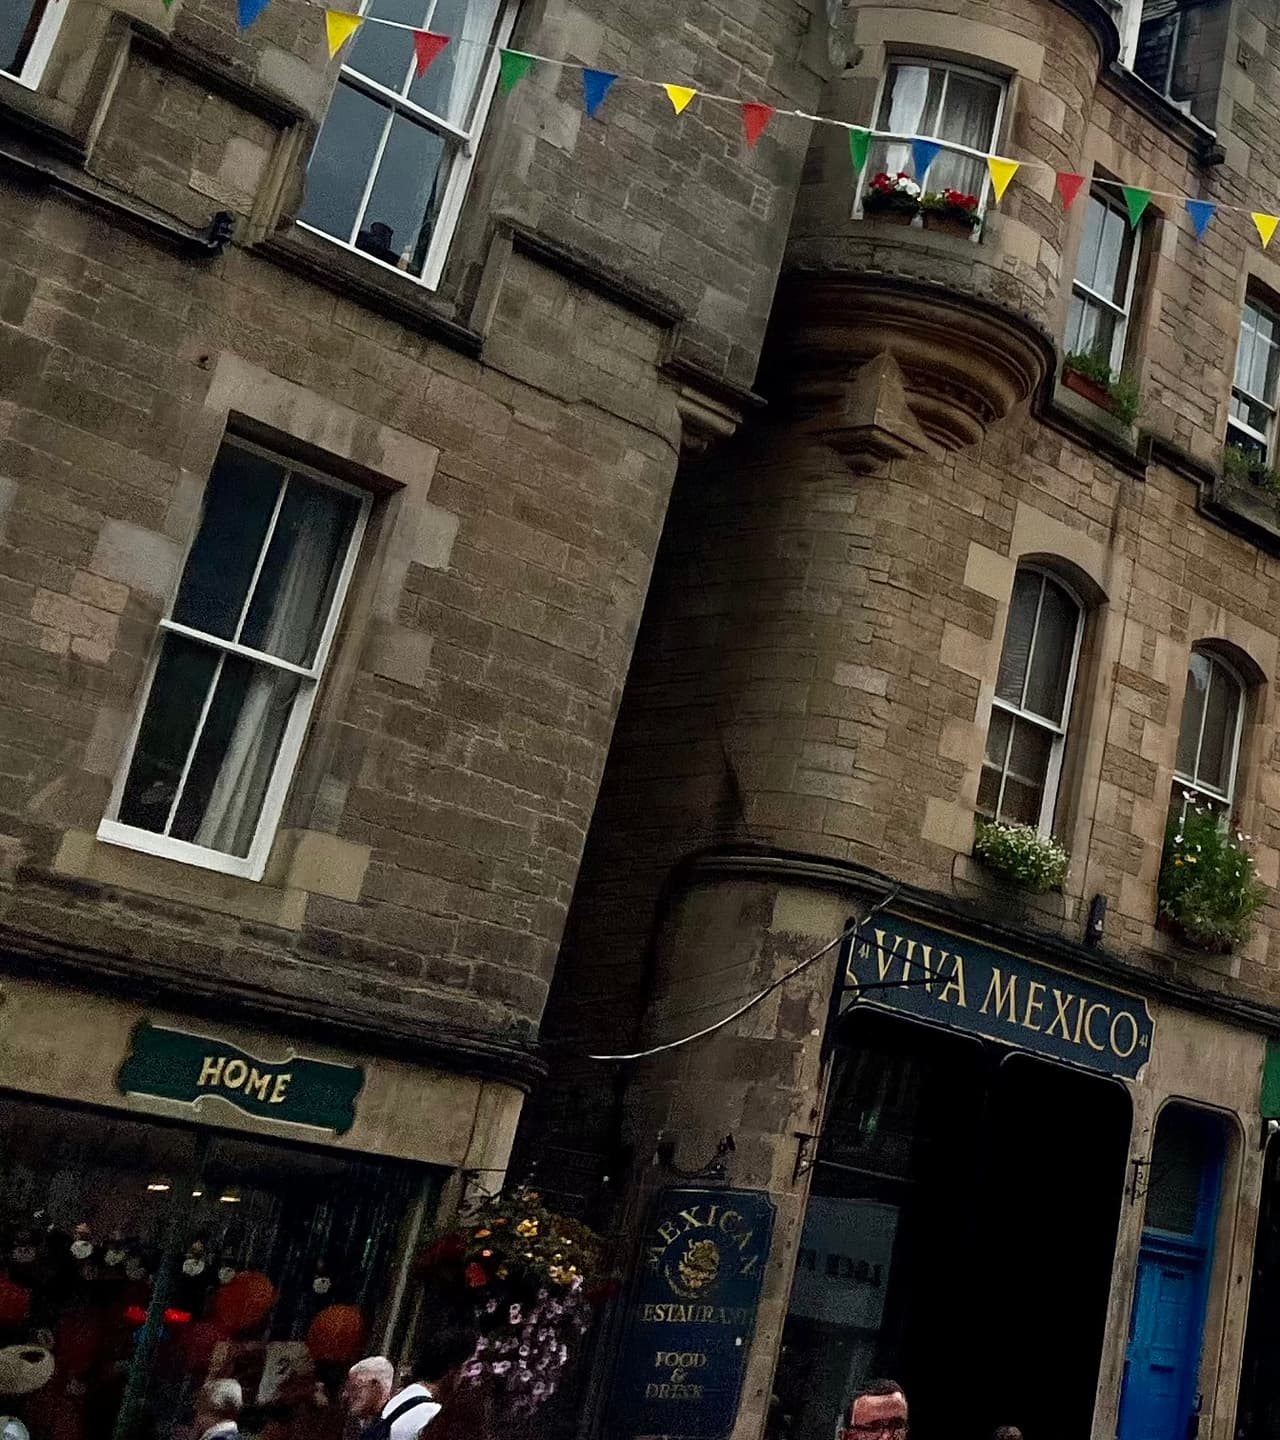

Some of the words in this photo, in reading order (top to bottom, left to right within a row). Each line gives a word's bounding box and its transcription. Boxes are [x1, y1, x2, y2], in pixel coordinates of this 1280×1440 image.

[872, 926, 968, 1008] VIVA
[978, 966, 1139, 1058] MEXICO
[196, 1055, 292, 1104] HOME
[654, 1350, 707, 1368] FOOD
